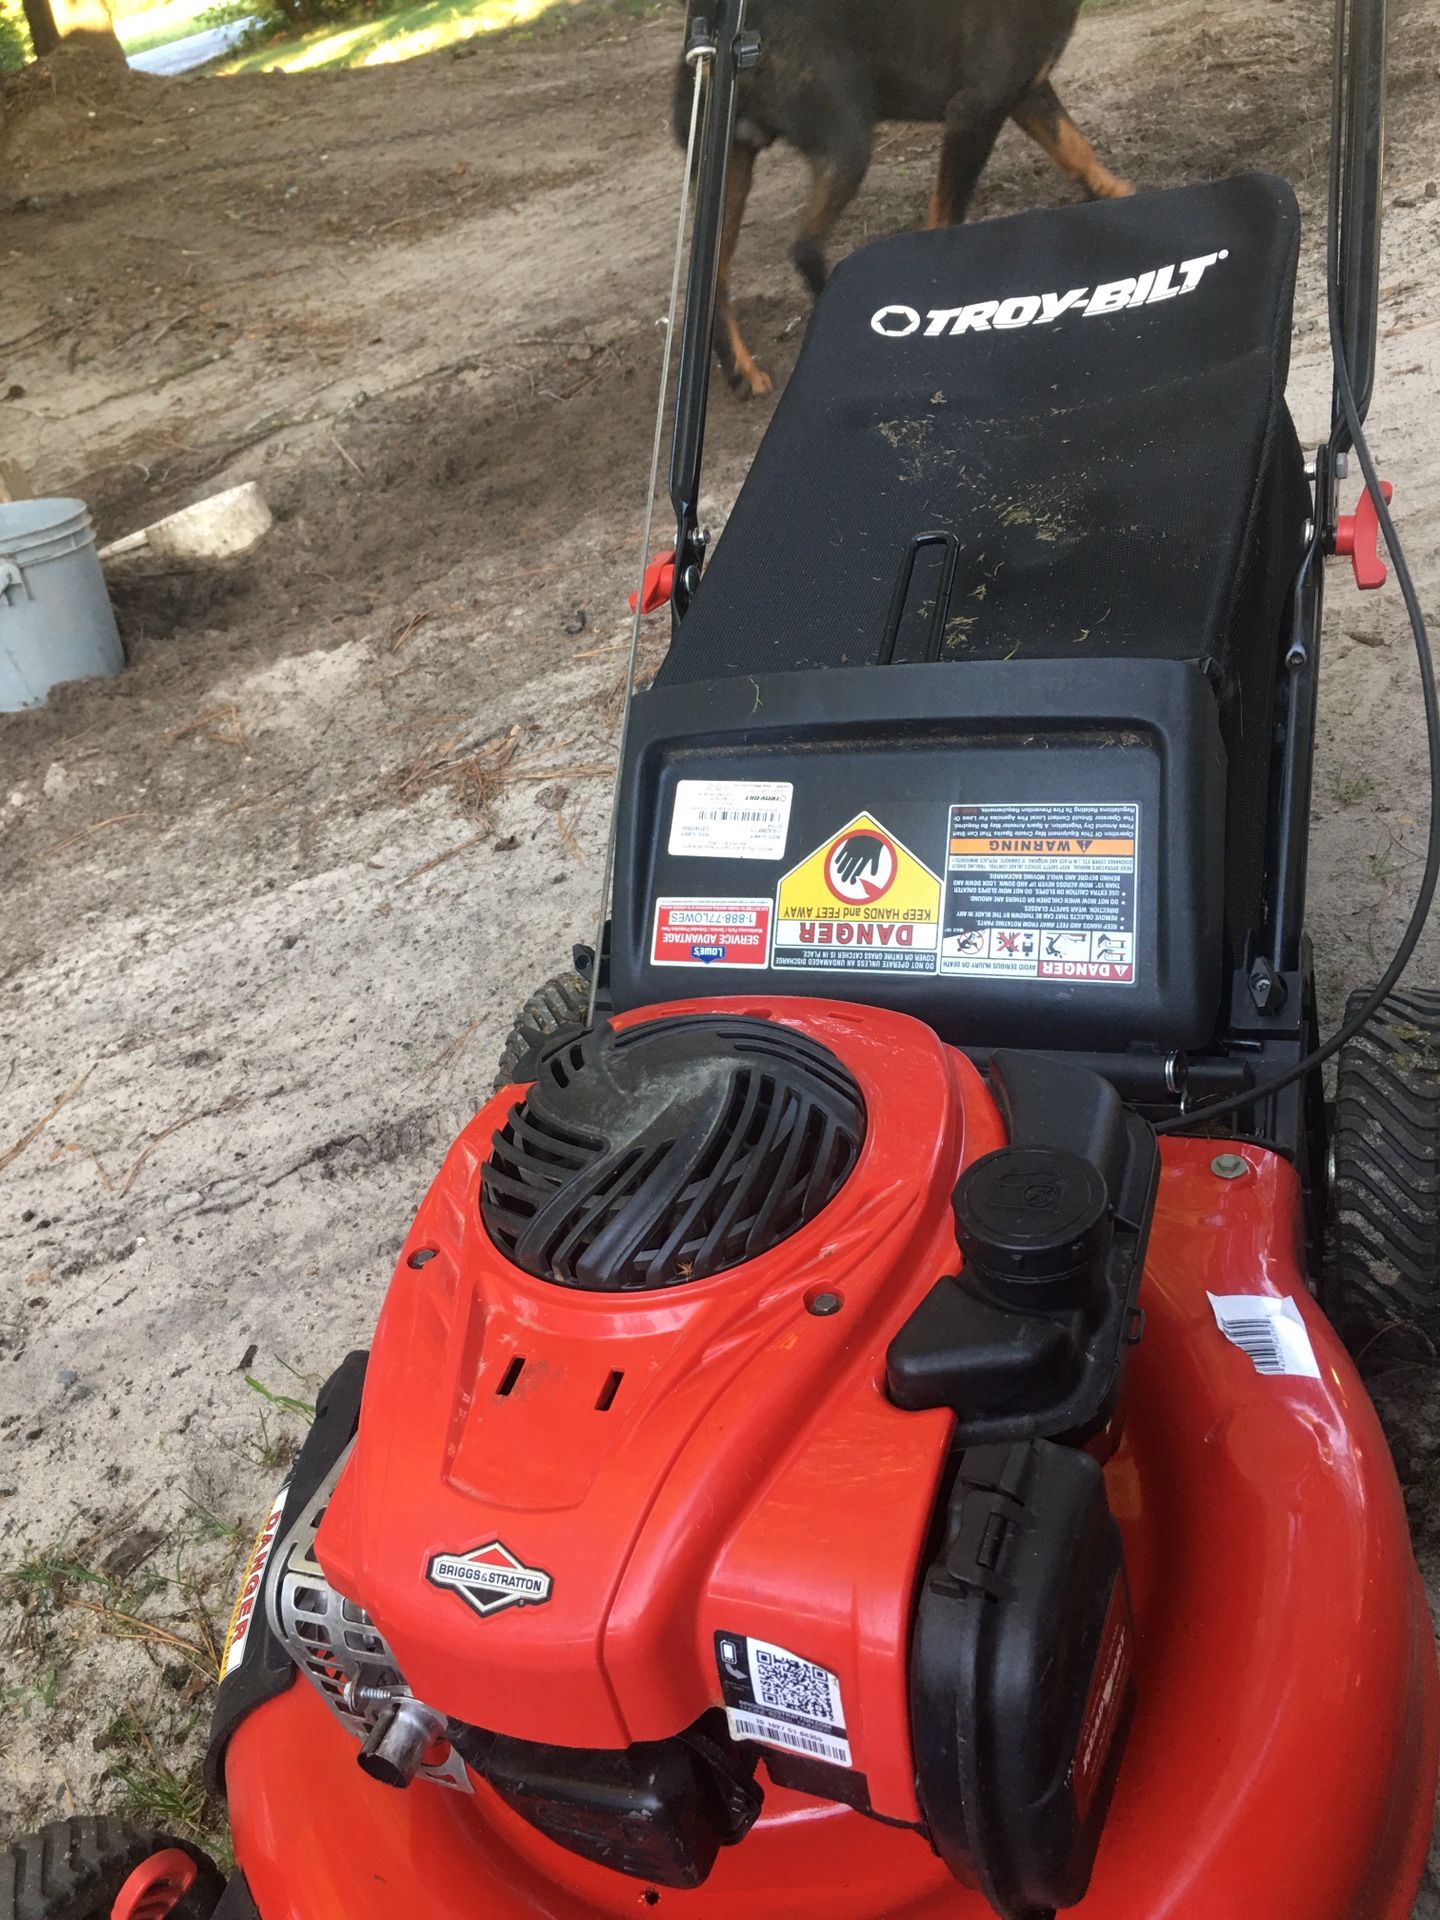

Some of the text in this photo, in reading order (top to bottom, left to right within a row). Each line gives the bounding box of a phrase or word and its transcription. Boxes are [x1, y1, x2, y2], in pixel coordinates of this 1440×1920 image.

[923, 250, 1218, 336] TROY-BILT
[989, 840, 1070, 851] WARNING
[671, 913, 753, 923] 1-888-77LOWES
[784, 907, 930, 920] KEEP HANDS and FEET AWAY
[663, 933, 759, 945] SERVICE ADVANTAGE
[799, 923, 913, 946] DANGER
[693, 947, 722, 957] LOWE'S
[775, 957, 806, 965] DISCHARGE
[808, 958, 845, 966] UNDAMAGED
[847, 959, 855, 967] AN
[925, 962, 934, 970] DO
[1043, 962, 1110, 976] DANGER
[232, 1510, 282, 1643] DANGER
